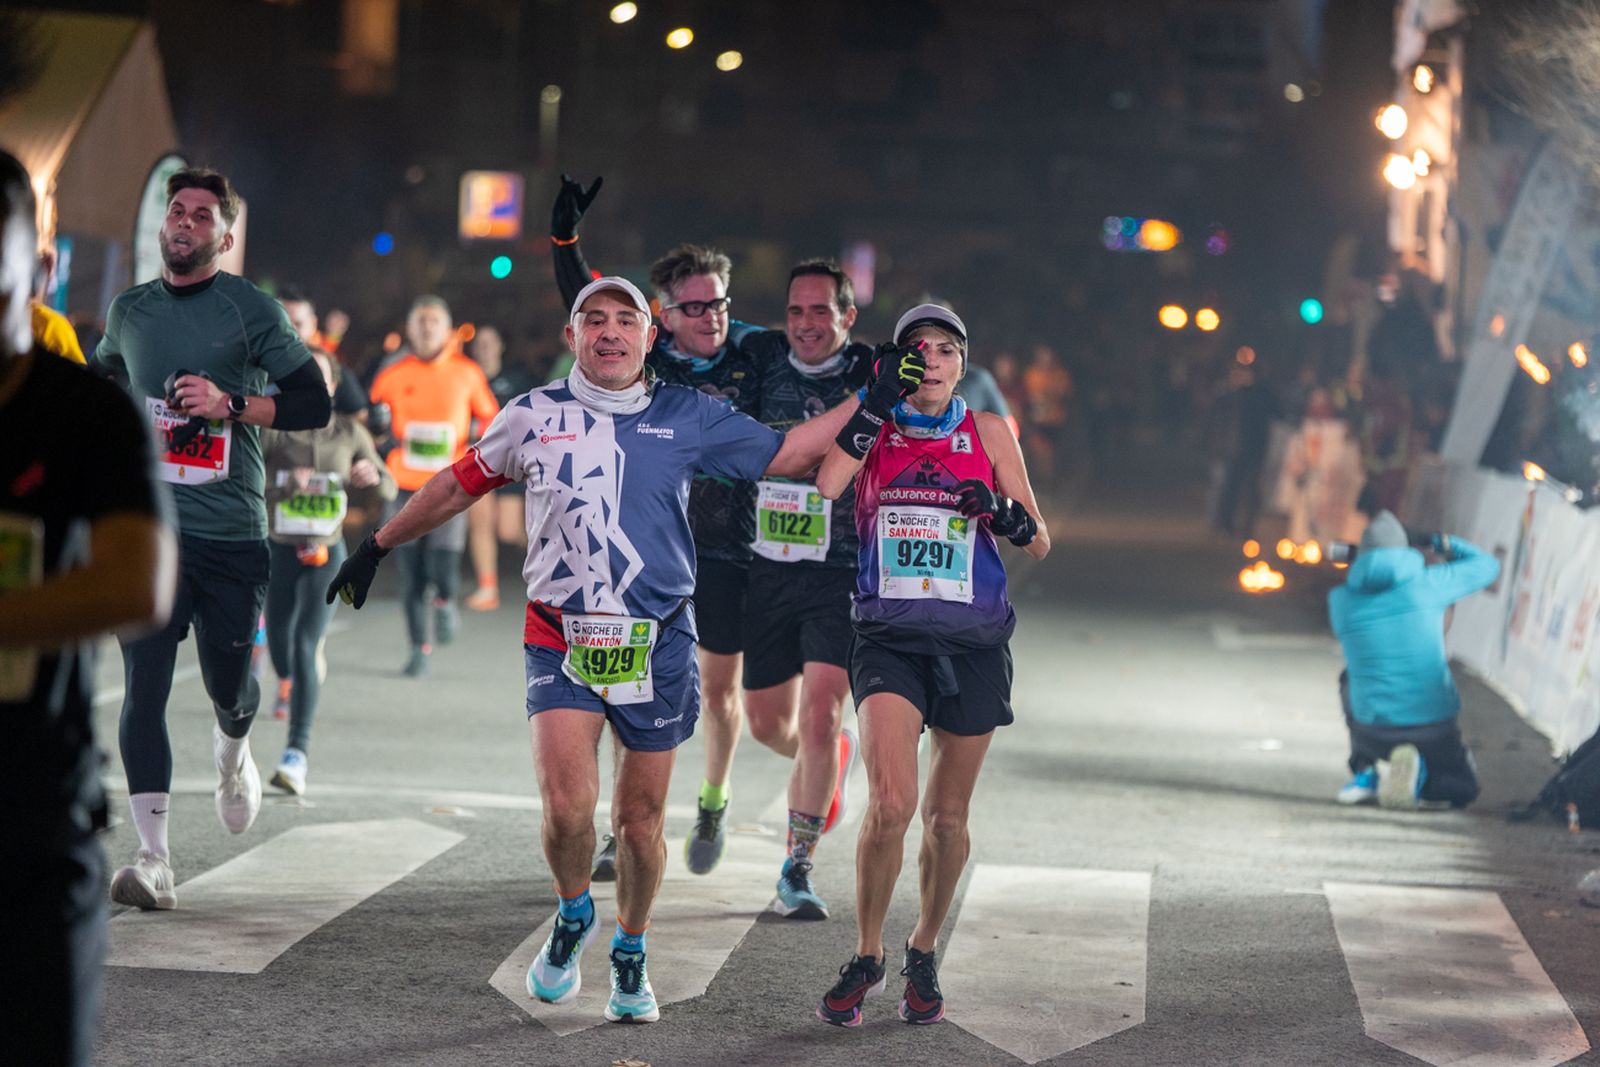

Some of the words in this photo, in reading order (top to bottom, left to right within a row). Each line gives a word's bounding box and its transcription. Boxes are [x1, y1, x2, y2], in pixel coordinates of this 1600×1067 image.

[914, 472, 941, 485] AC
[880, 488, 936, 500] endurance
[769, 511, 812, 537] 6122
[900, 516, 928, 526] NOCHE
[930, 518, 940, 528] DE
[889, 528, 908, 538] SAN
[909, 527, 939, 539] ANTÓN
[897, 540, 954, 570] 9297
[581, 626, 611, 635] NOCHE
[612, 627, 624, 635] DE
